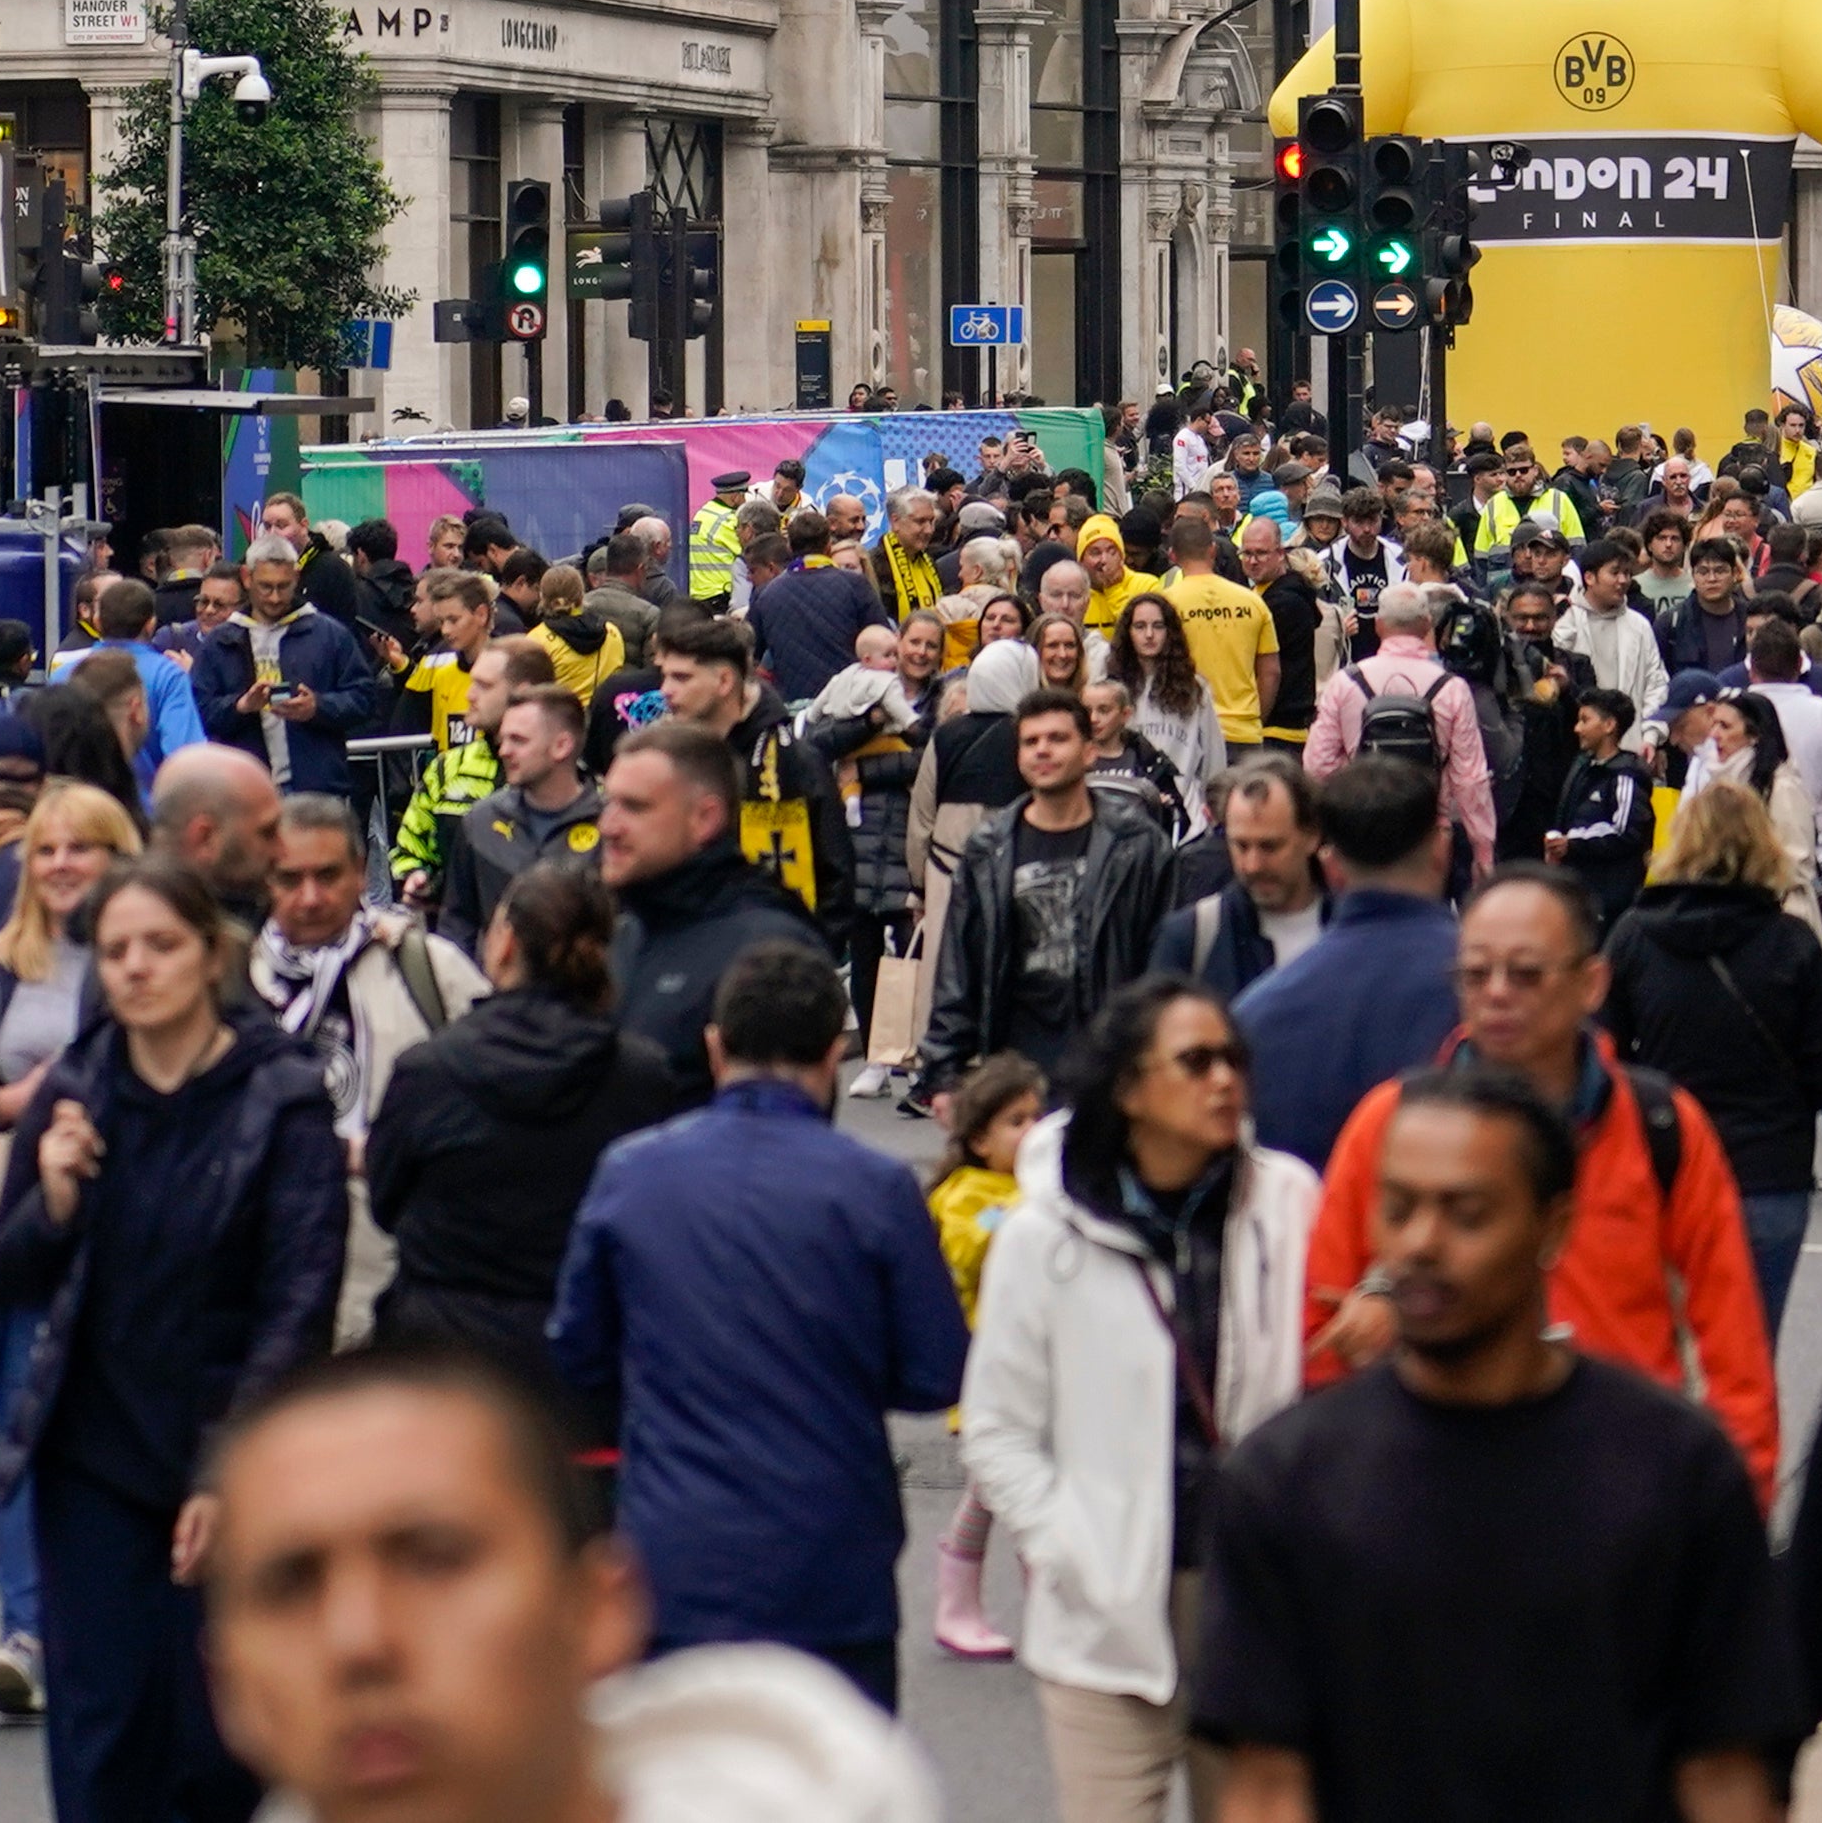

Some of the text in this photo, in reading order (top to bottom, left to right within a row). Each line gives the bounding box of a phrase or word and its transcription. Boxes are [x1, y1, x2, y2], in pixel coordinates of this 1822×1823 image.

[72, 0, 128, 13] HANOVER
[72, 15, 139, 28] STREET W1
[501, 17, 558, 53] LONGCHAMP
[1564, 39, 1628, 88] BVB
[1583, 88, 1606, 104] 09
[1663, 156, 1730, 200] 24
[1522, 211, 1665, 230] FINAL
[1235, 606, 1252, 619] 24
